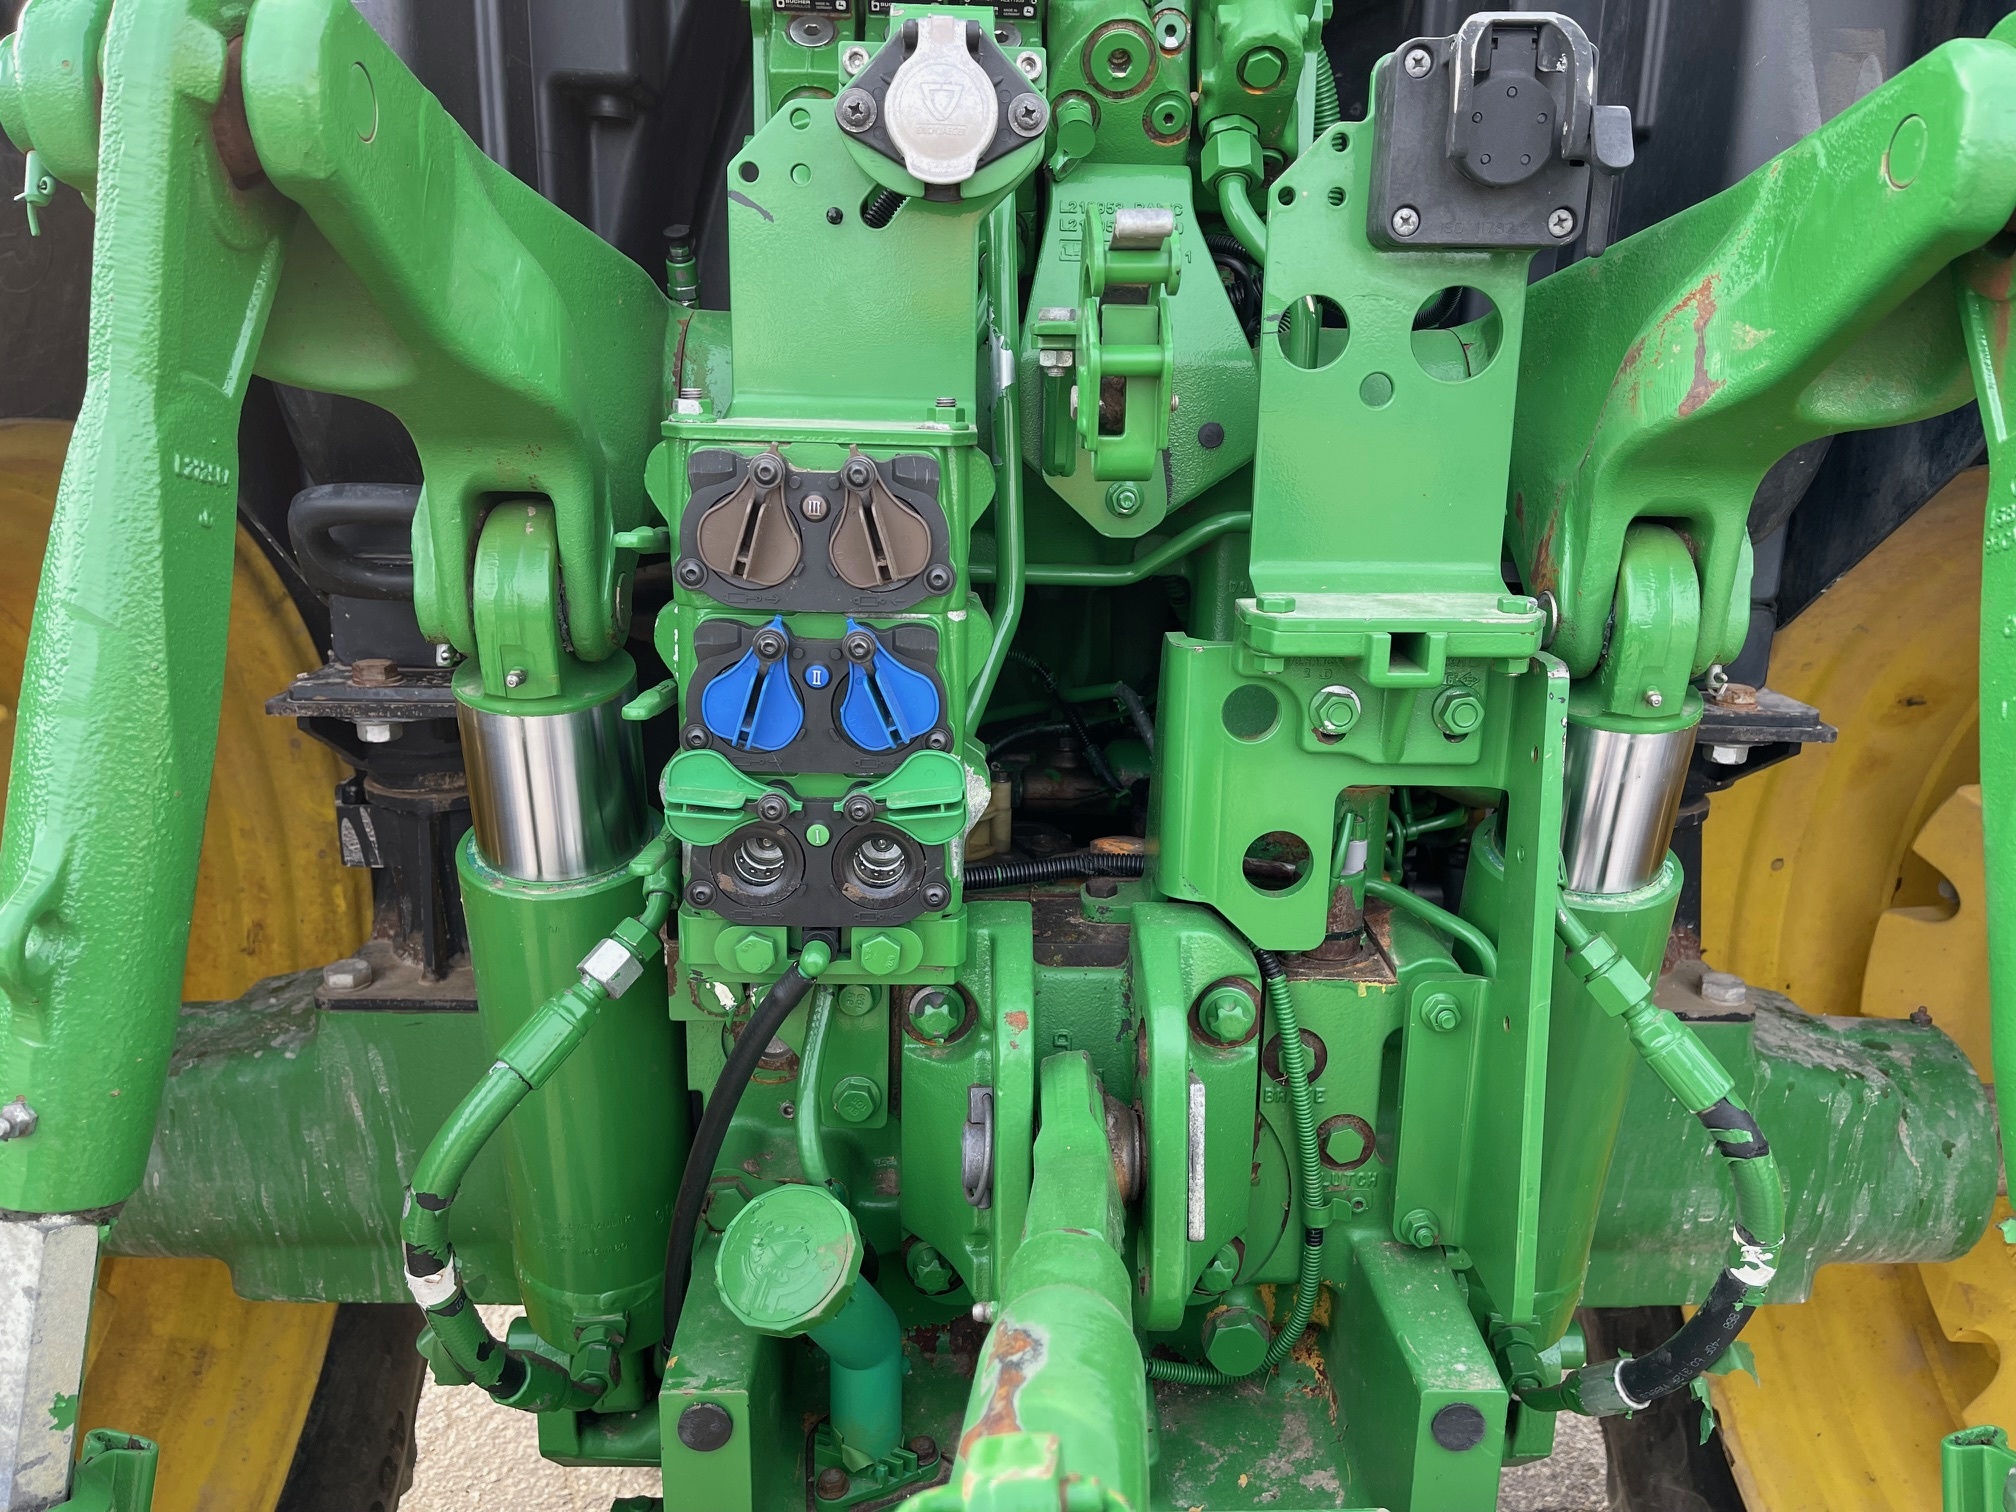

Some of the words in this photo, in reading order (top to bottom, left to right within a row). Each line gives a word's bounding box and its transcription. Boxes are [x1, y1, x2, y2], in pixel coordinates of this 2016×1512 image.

[1440, 221, 1463, 235] ISO
[807, 500, 822, 516] III
[812, 669, 822, 685] II
[814, 829, 821, 844] I
[1263, 1086, 1327, 1104] BRE
[1320, 1172, 1379, 1188] LUTCH
